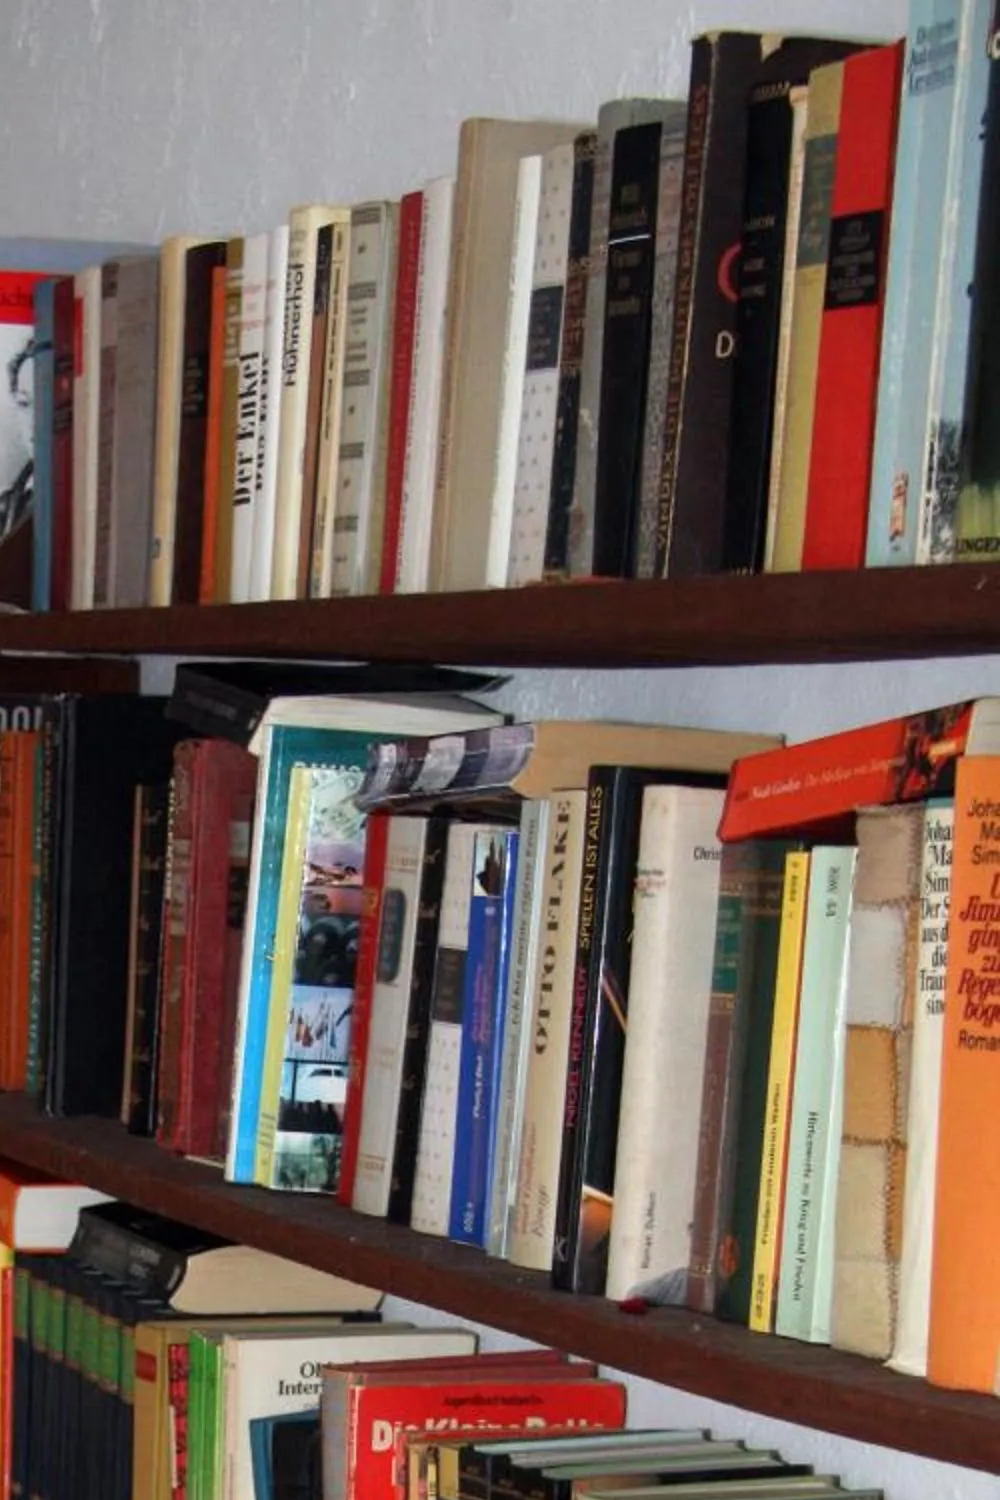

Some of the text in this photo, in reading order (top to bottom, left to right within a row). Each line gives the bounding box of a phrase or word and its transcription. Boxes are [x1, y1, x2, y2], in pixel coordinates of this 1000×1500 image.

[233, 350, 260, 507] Der Enkel
[534, 800, 572, 1055] OTTO FLAKE
[579, 873, 597, 949] SPIELEN
[588, 785, 603, 845] ALLES
[565, 962, 587, 1128] NIGEL KENNEDY
